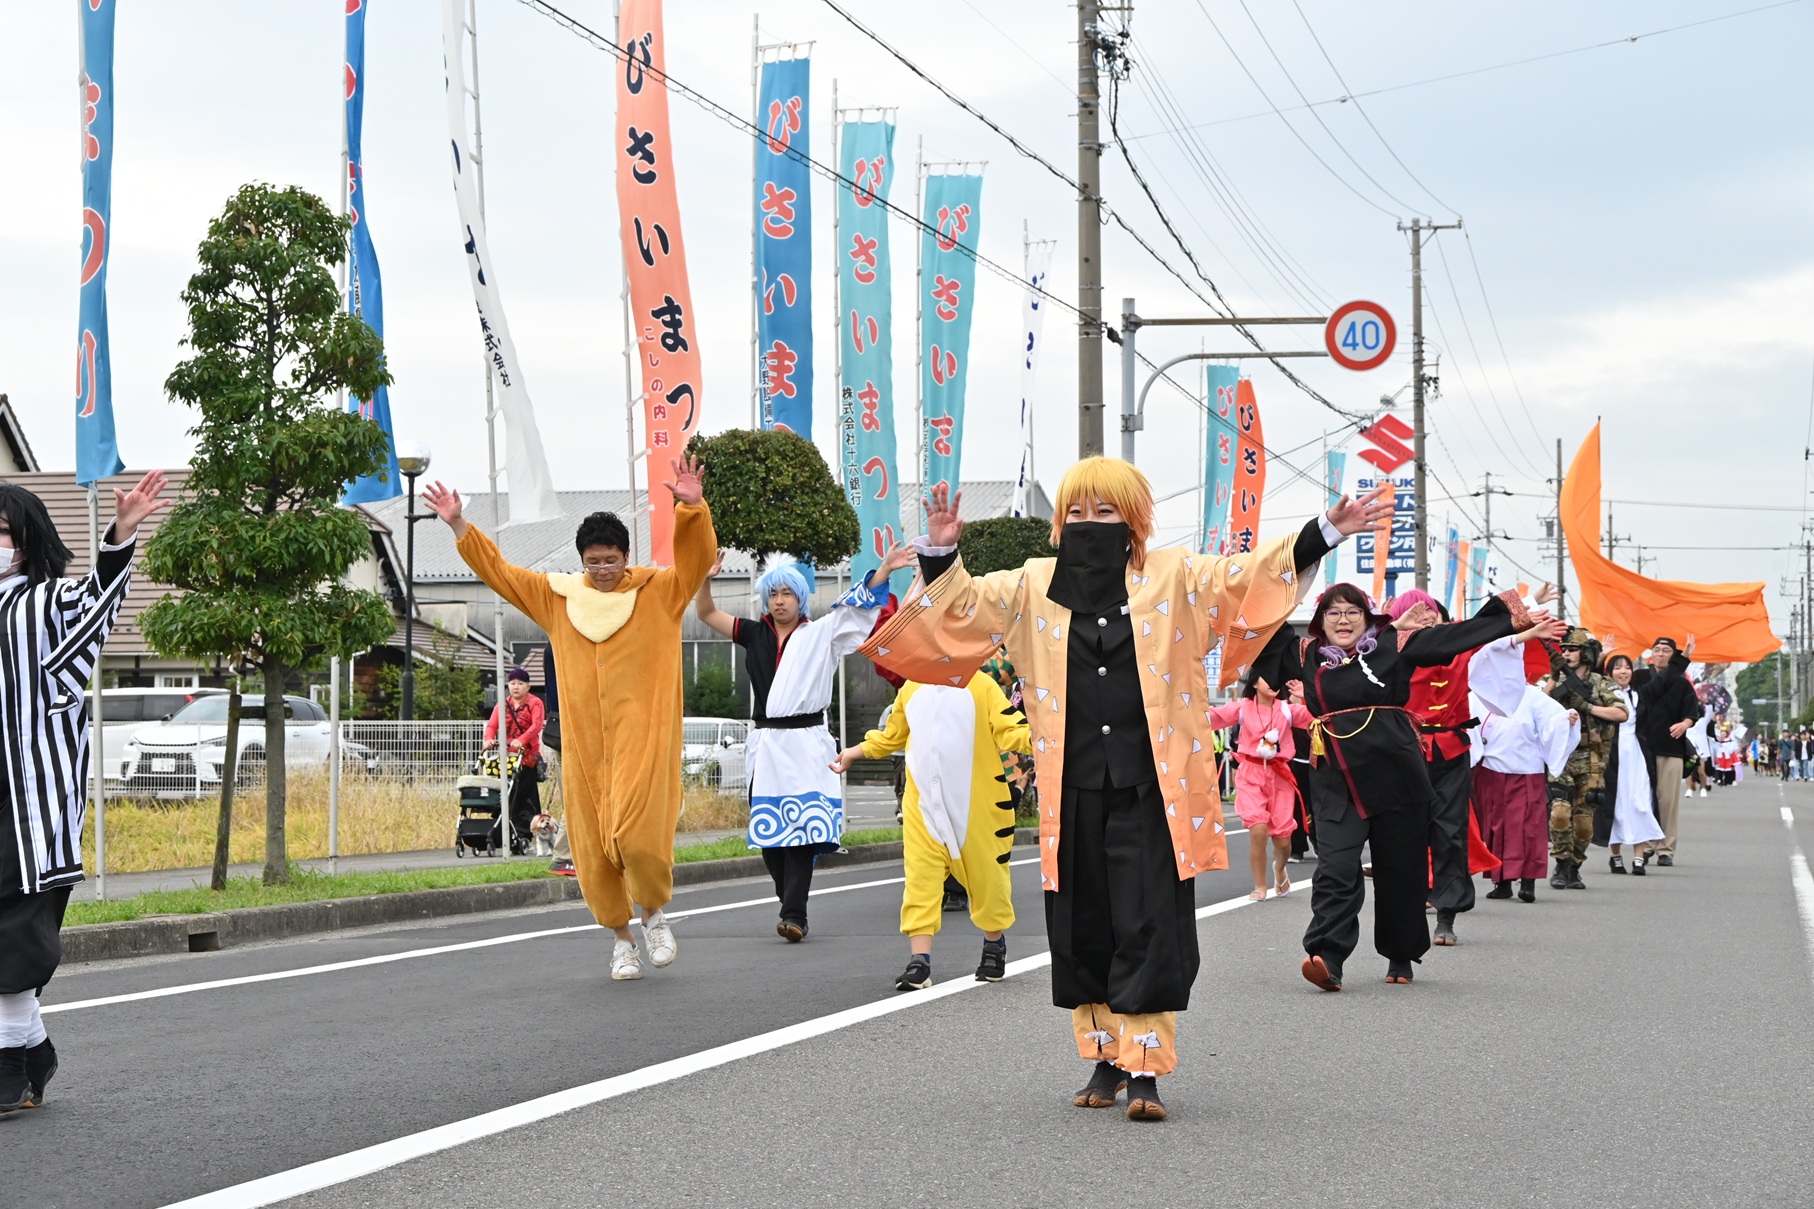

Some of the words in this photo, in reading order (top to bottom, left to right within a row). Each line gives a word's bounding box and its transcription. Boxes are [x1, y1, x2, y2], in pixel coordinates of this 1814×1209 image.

[760, 95, 802, 431] びさいま
[644, 326, 670, 447] こしの内科
[849, 154, 895, 560] びさいまつり
[1342, 320, 1380, 351] 40
[841, 386, 862, 507] 株式会社十六銀行
